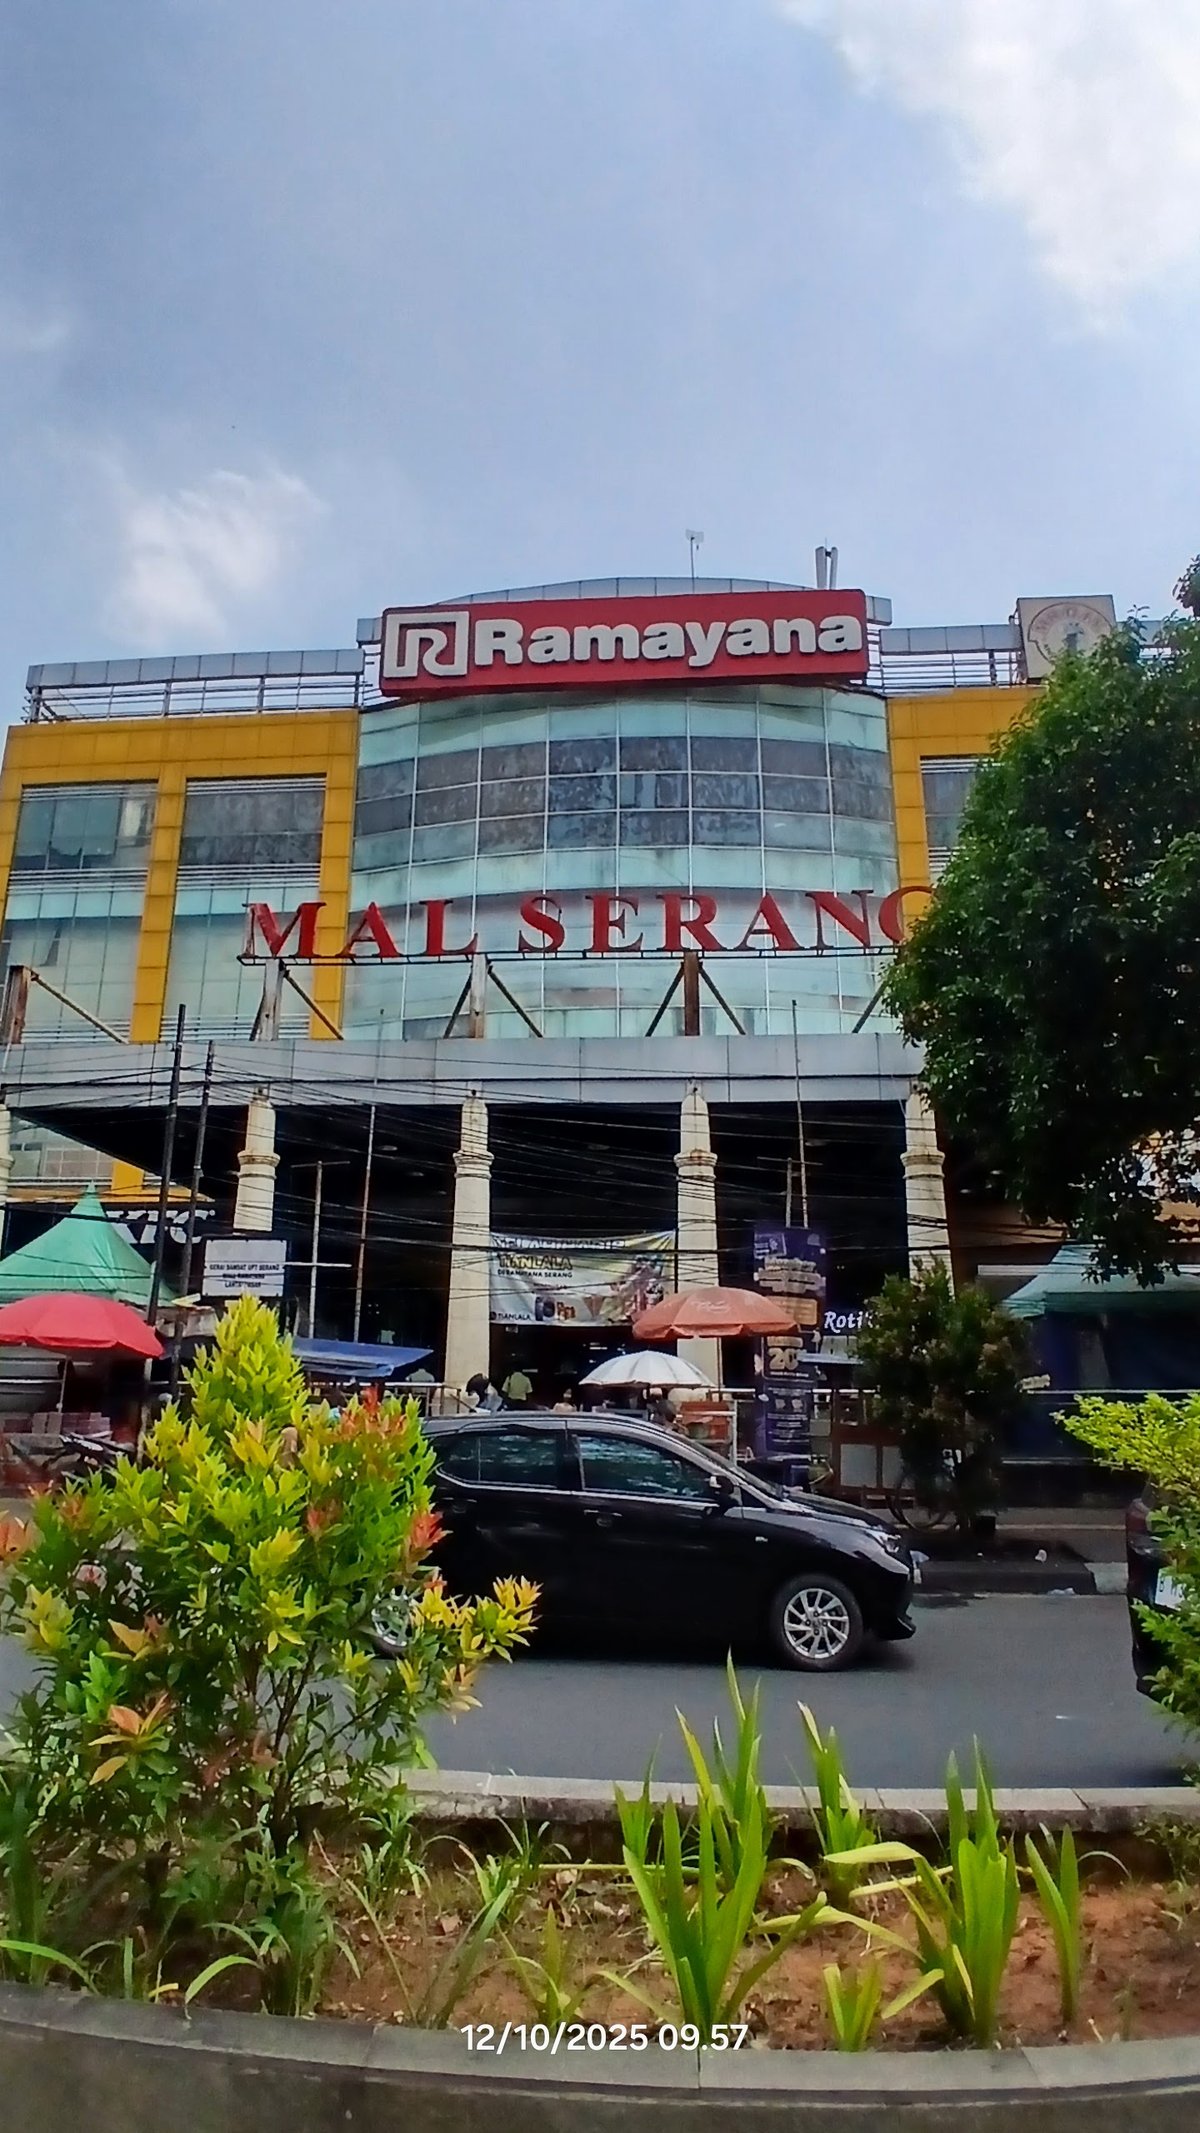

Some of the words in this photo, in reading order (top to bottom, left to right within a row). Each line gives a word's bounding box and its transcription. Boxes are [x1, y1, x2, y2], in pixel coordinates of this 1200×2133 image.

[474, 615, 863, 668] Ramayana
[242, 900, 478, 957] MAL
[544, 1271, 573, 1279] SERANG
